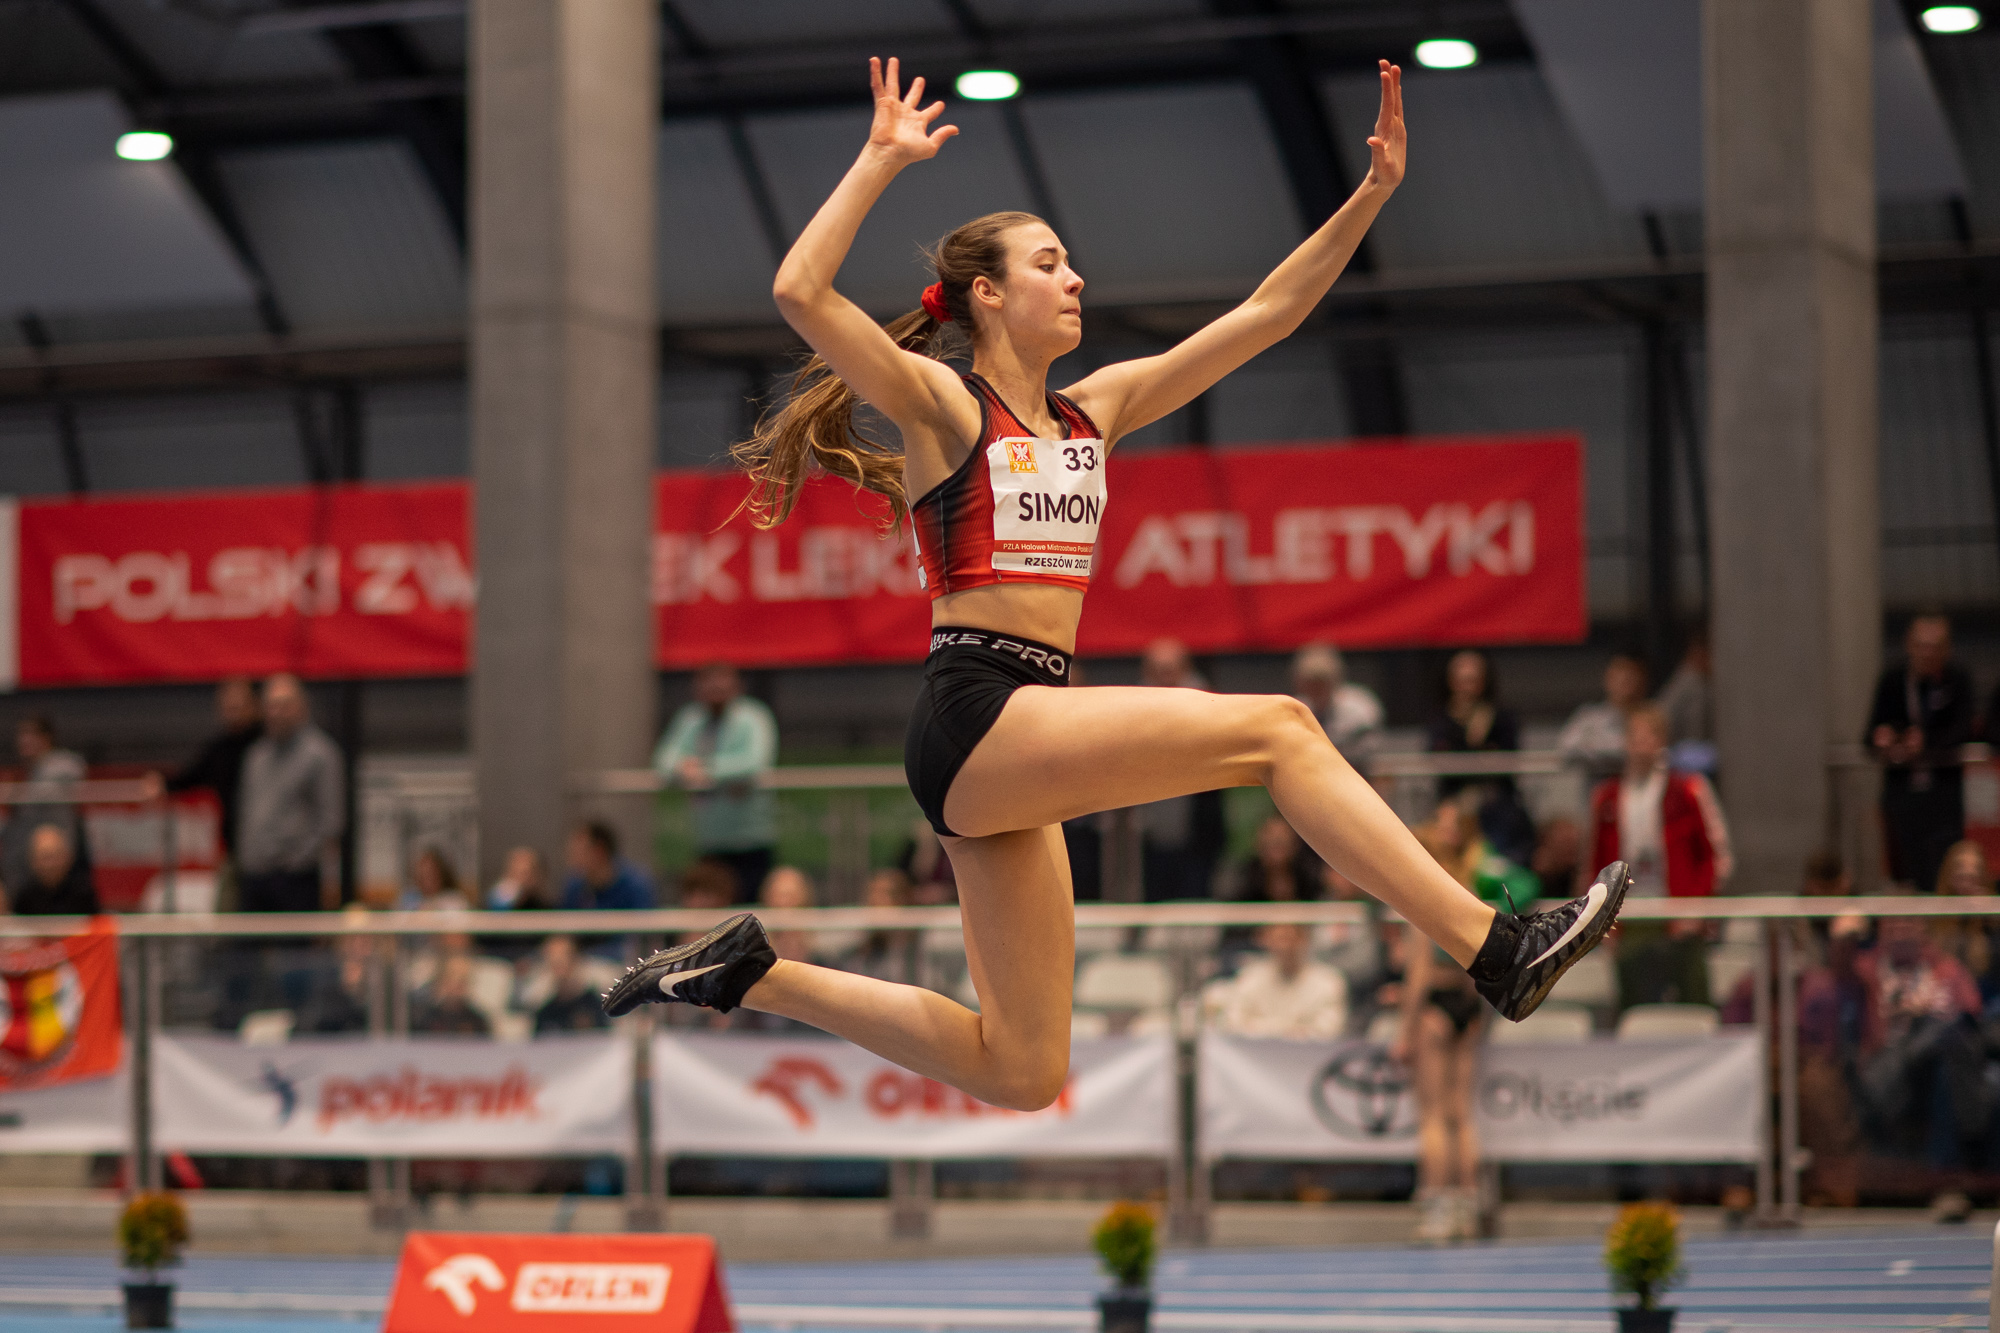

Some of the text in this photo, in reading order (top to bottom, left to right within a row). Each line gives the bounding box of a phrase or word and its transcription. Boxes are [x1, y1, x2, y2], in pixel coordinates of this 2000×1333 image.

[1011, 461, 1037, 472] PZLA
[1018, 492, 1099, 525] SIMON
[1003, 543, 1020, 551] PZLA
[1021, 543, 1046, 551] Halowe
[1046, 544, 1077, 552] Mistrzostwa
[54, 545, 341, 624] POLSKI
[1115, 499, 1535, 590] ATLETYKI
[1024, 556, 1073, 569] RZESZÓW
[991, 639, 1065, 676] PRO
